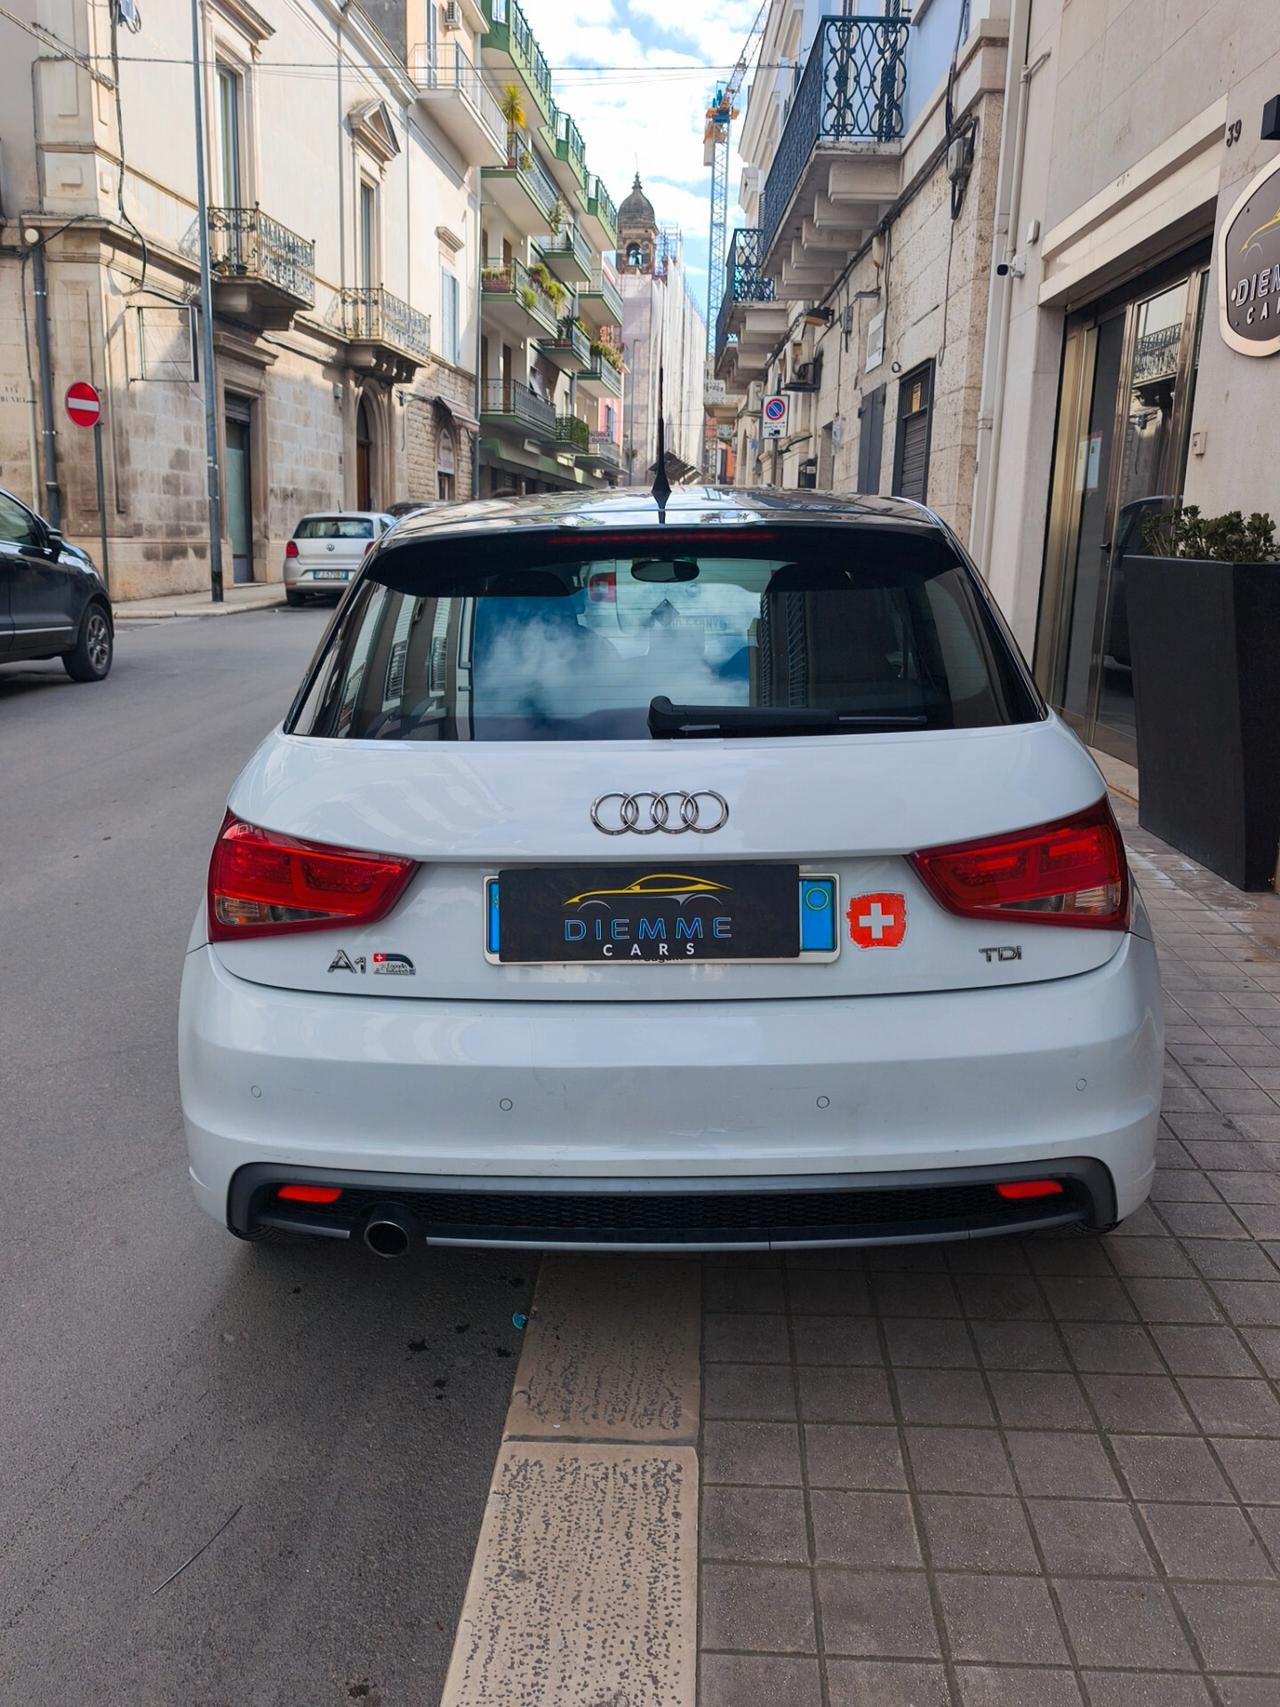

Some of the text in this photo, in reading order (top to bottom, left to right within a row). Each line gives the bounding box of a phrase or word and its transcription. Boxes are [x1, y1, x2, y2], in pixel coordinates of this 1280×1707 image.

[1226, 119, 1242, 148] 39
[564, 917, 733, 941] DIEMME
[327, 949, 367, 974] A1
[602, 943, 695, 957] CARS
[978, 945, 1022, 963] TDI
